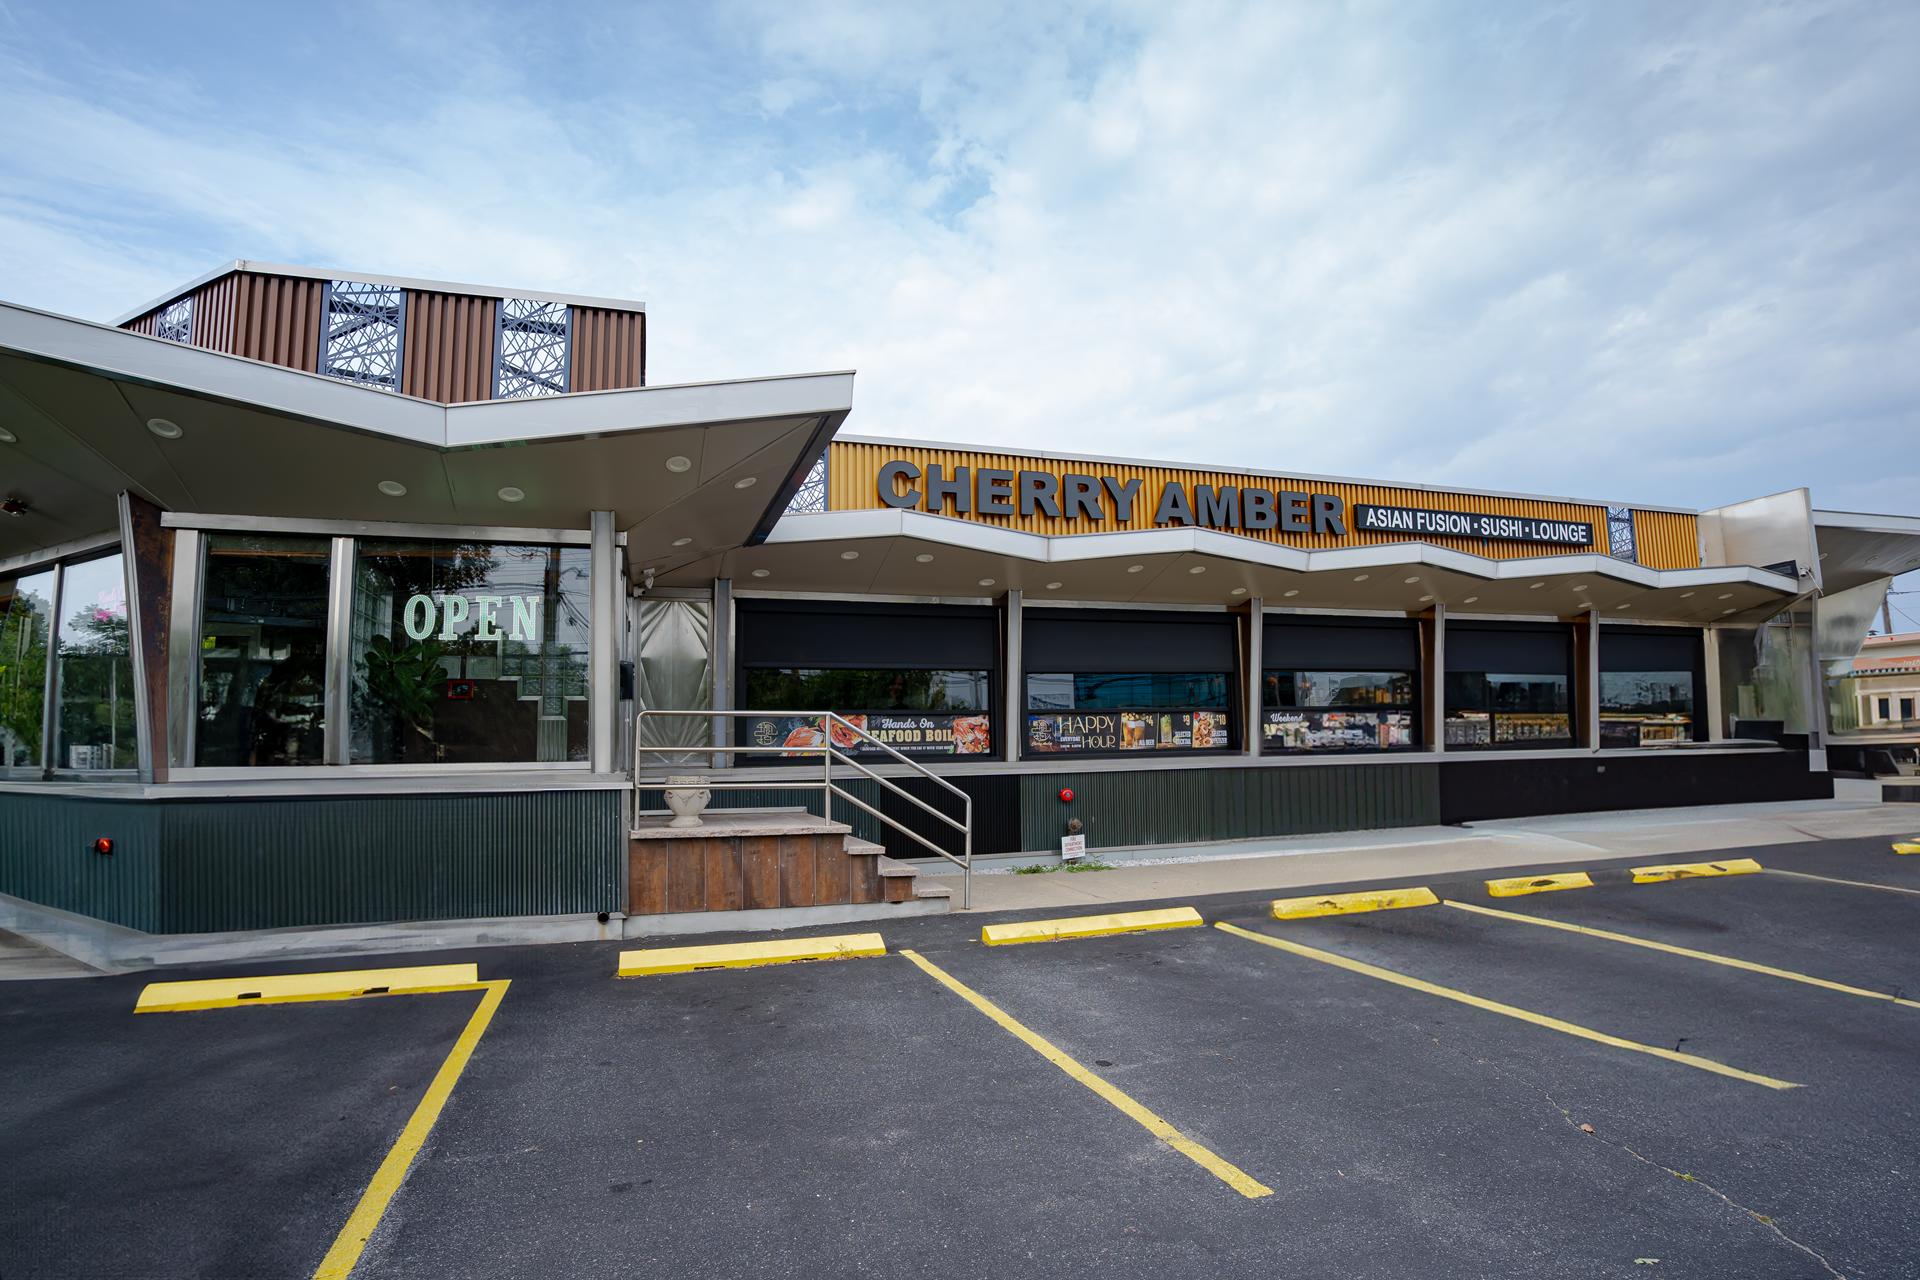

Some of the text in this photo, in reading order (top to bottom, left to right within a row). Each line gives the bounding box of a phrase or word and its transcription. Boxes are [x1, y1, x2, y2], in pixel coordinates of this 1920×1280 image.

[877, 459, 1347, 535] CHERRY AMBER
[1366, 508, 1587, 542] ASIAN FUSION SUSHI LOUNGE
[403, 594, 540, 641] OPEN
[881, 718, 935, 728] Hands On
[1059, 716, 1116, 733] HAPPY
[1270, 713, 1304, 722] Weekend
[925, 729, 956, 742] BOIL
[1082, 735, 1116, 748] HOUR
